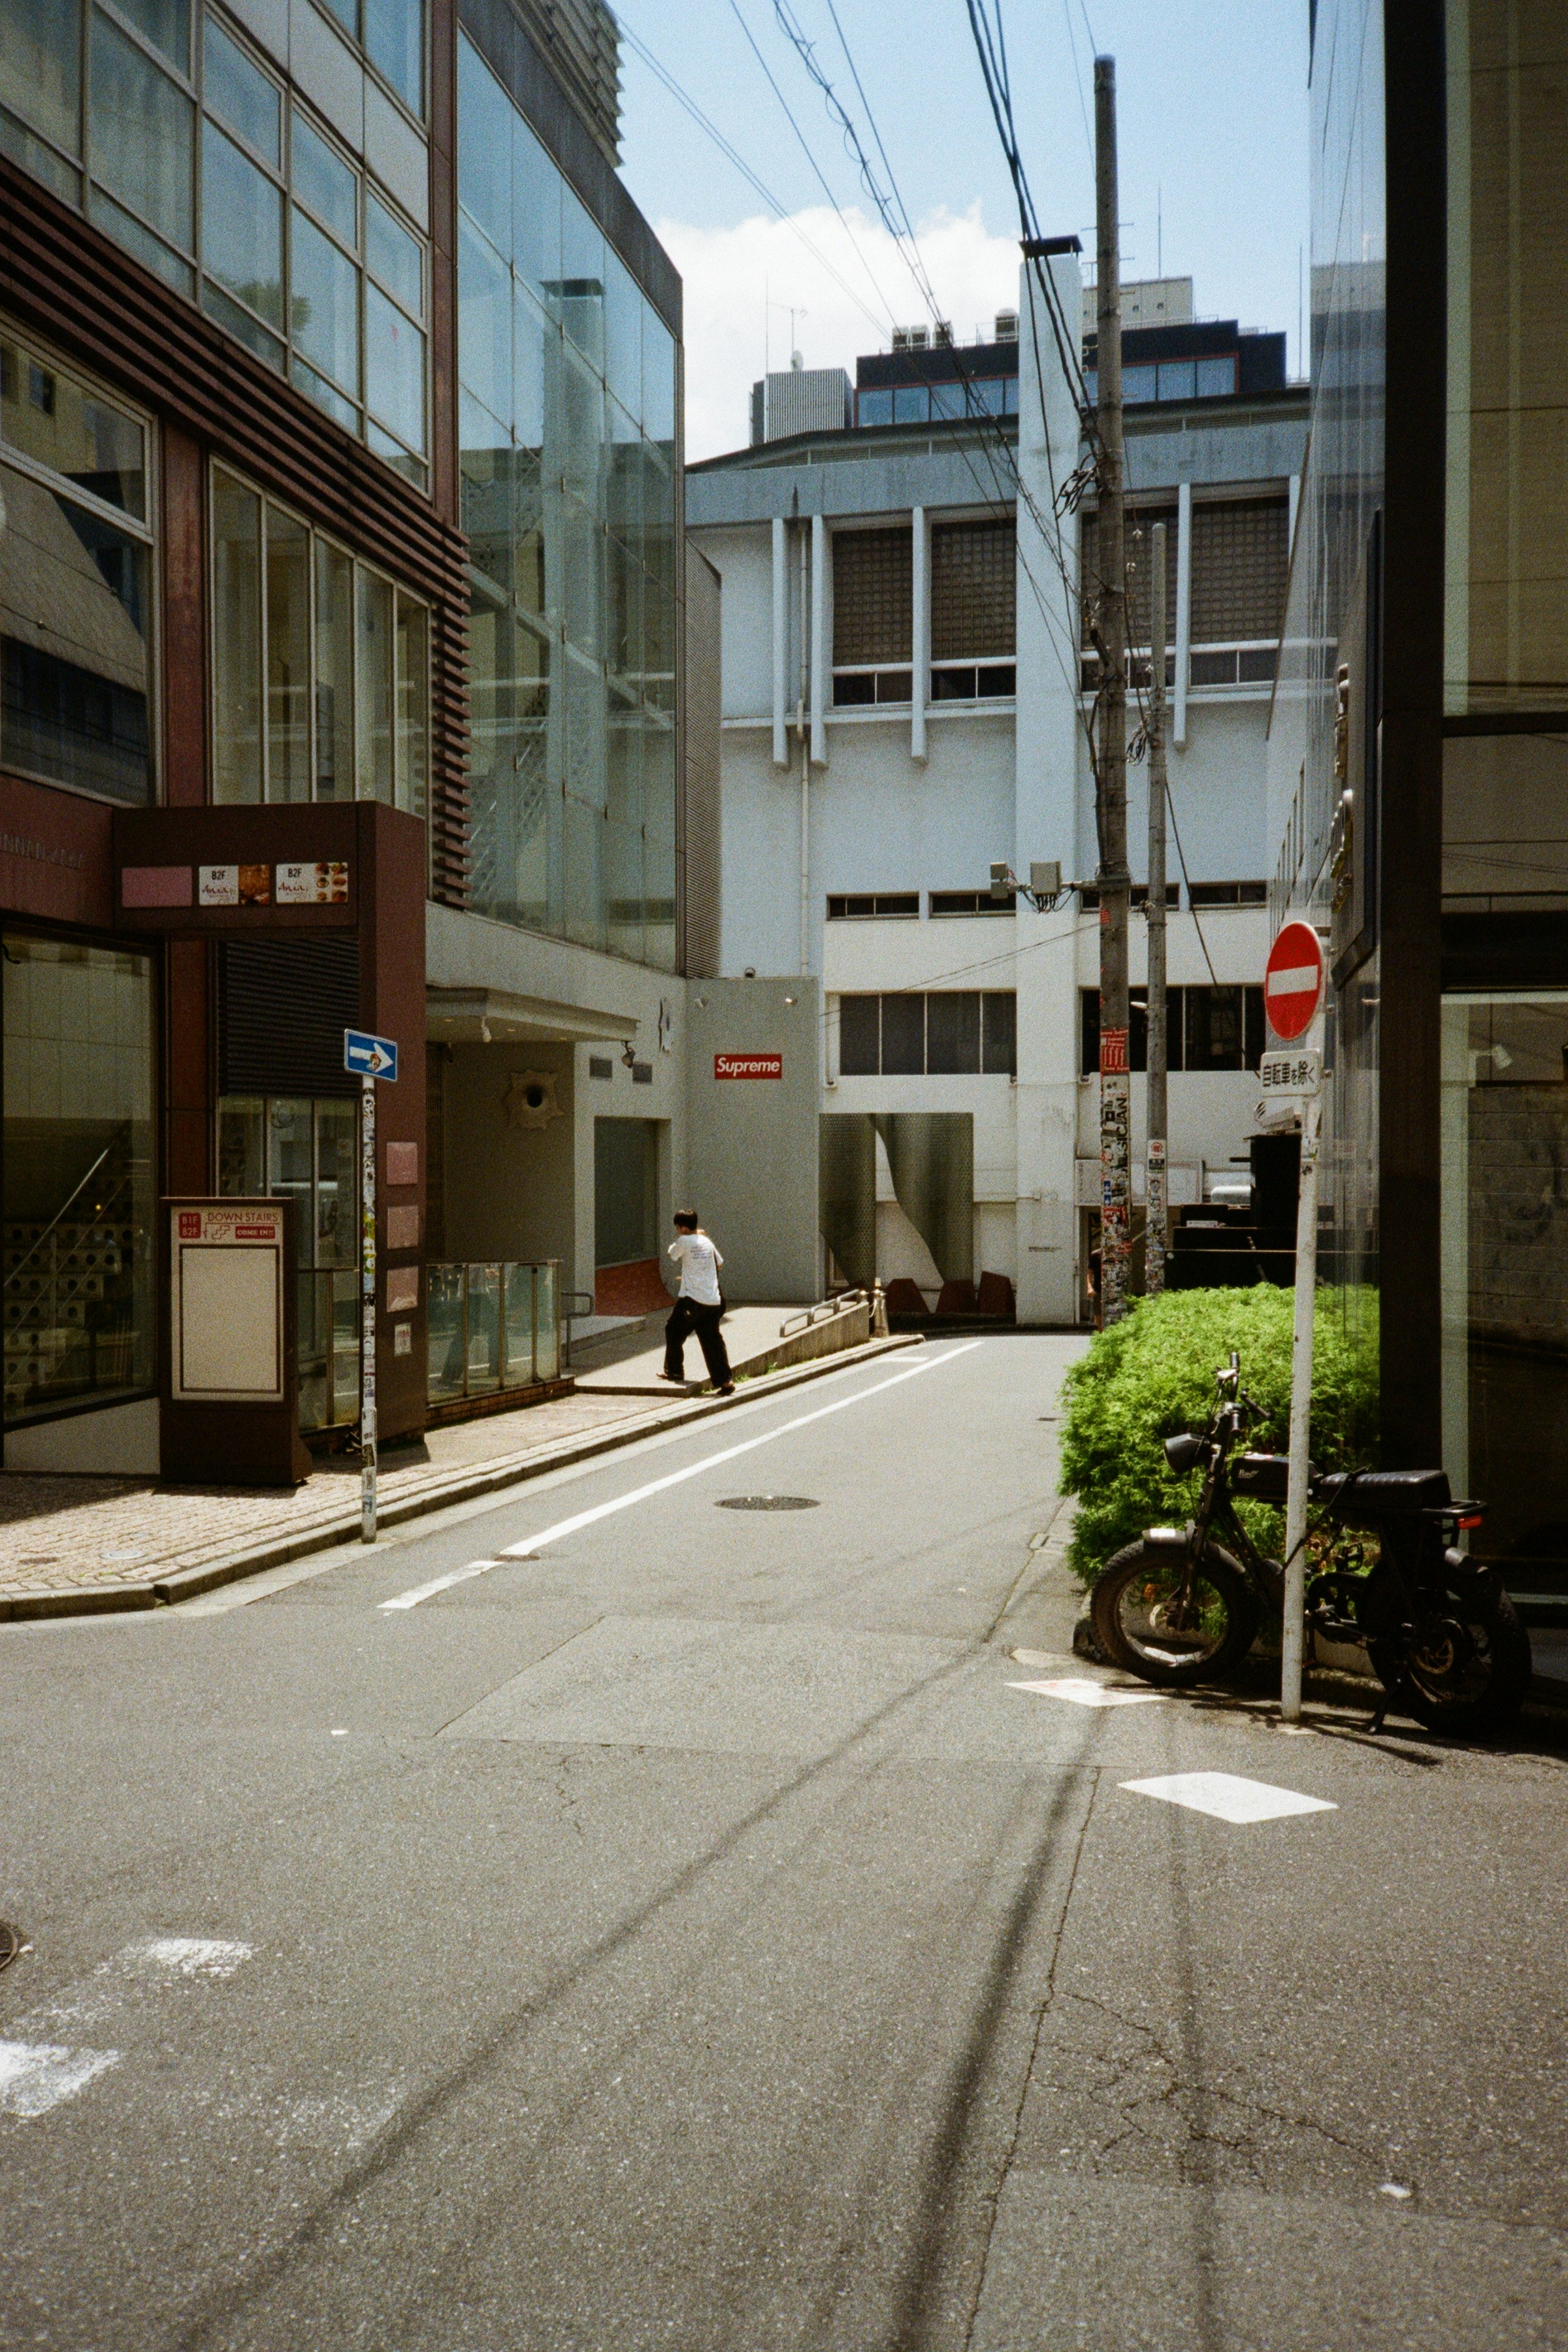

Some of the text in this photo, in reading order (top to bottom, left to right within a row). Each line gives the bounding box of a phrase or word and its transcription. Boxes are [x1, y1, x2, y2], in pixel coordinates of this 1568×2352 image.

[212, 870, 226, 880] B2F
[288, 868, 302, 877] B2F
[717, 1056, 779, 1077] Supreme
[1263, 1060, 1315, 1087] 自転車を除く
[182, 1216, 197, 1224] B1F
[208, 1213, 278, 1222] DOWN STAIRS
[182, 1227, 198, 1236] B2F
